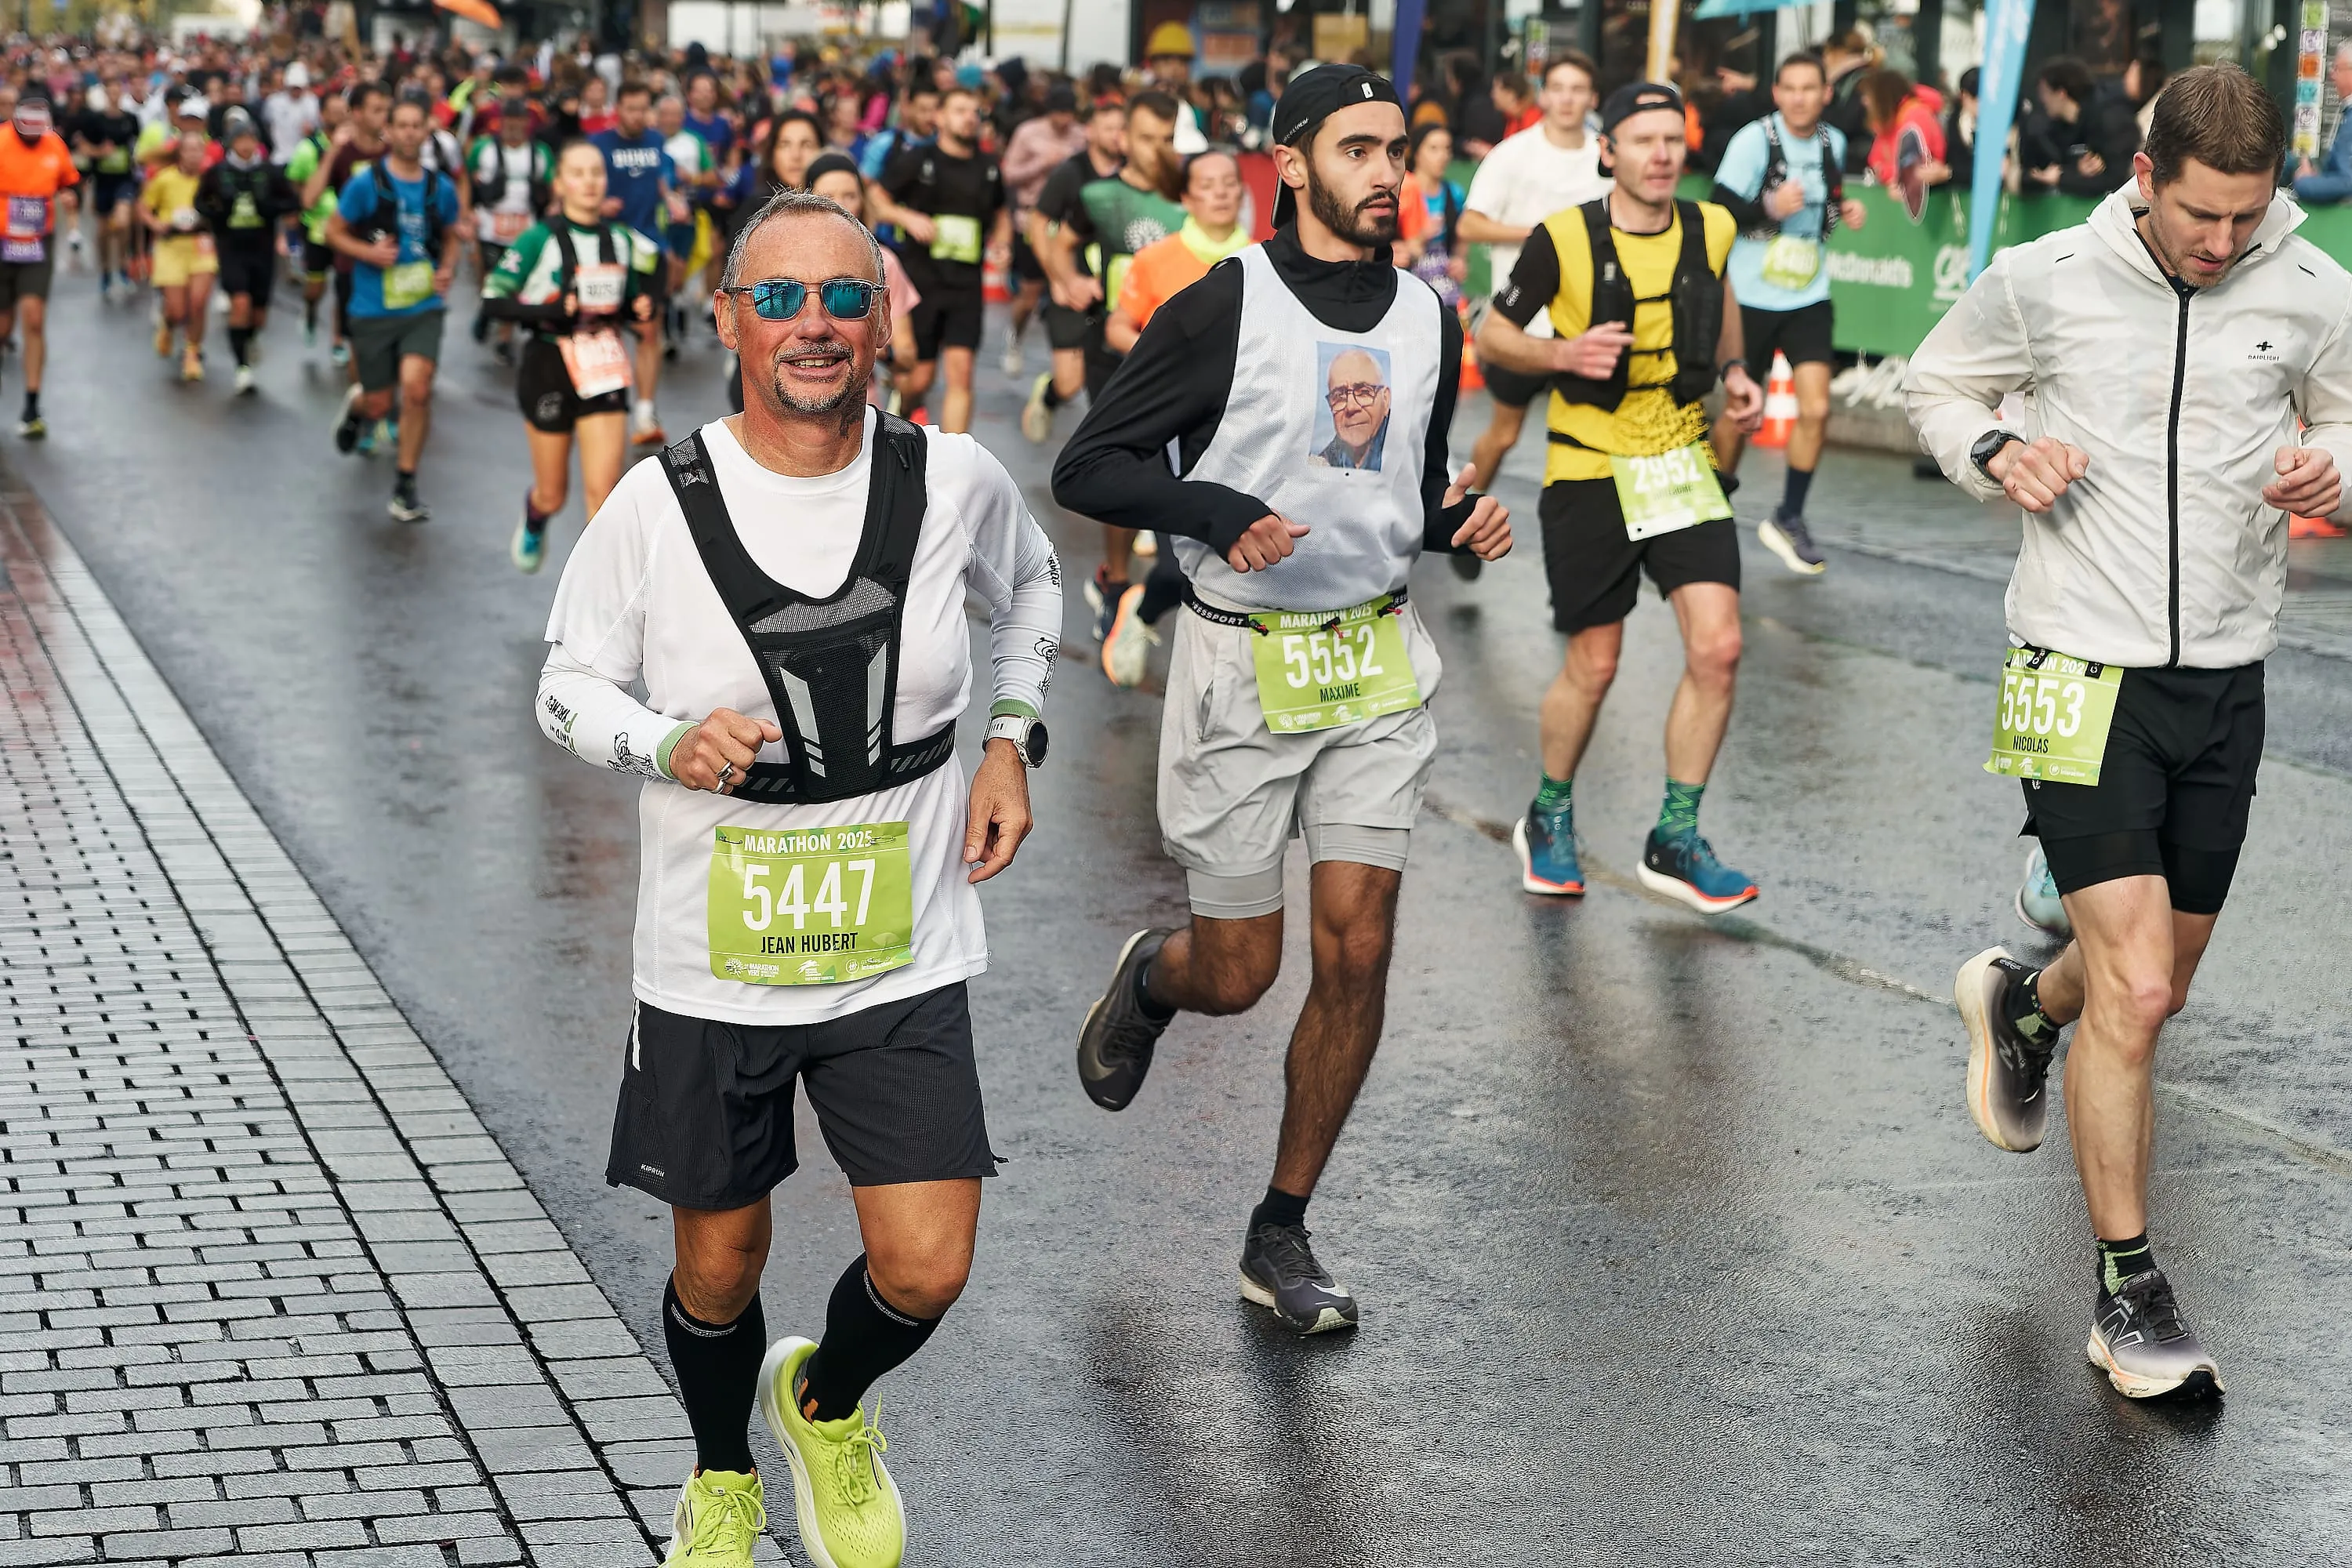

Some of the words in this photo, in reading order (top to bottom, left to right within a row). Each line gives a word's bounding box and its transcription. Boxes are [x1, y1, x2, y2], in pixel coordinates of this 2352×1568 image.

[1350, 603, 1372, 622] 2025
[1282, 625, 1384, 688] 5552
[2060, 659, 2085, 674] 202
[1319, 683, 1360, 702] MAXIME
[2002, 675, 2085, 738] 5553
[2013, 735, 2049, 753] NICOLAS
[744, 833, 831, 854] MARATHON
[837, 829, 873, 850] 2025
[742, 858, 876, 931] 5447
[760, 936, 795, 954] JEAN
[801, 932, 858, 953] HUBERT
[641, 1163, 665, 1178] KIPRUN
